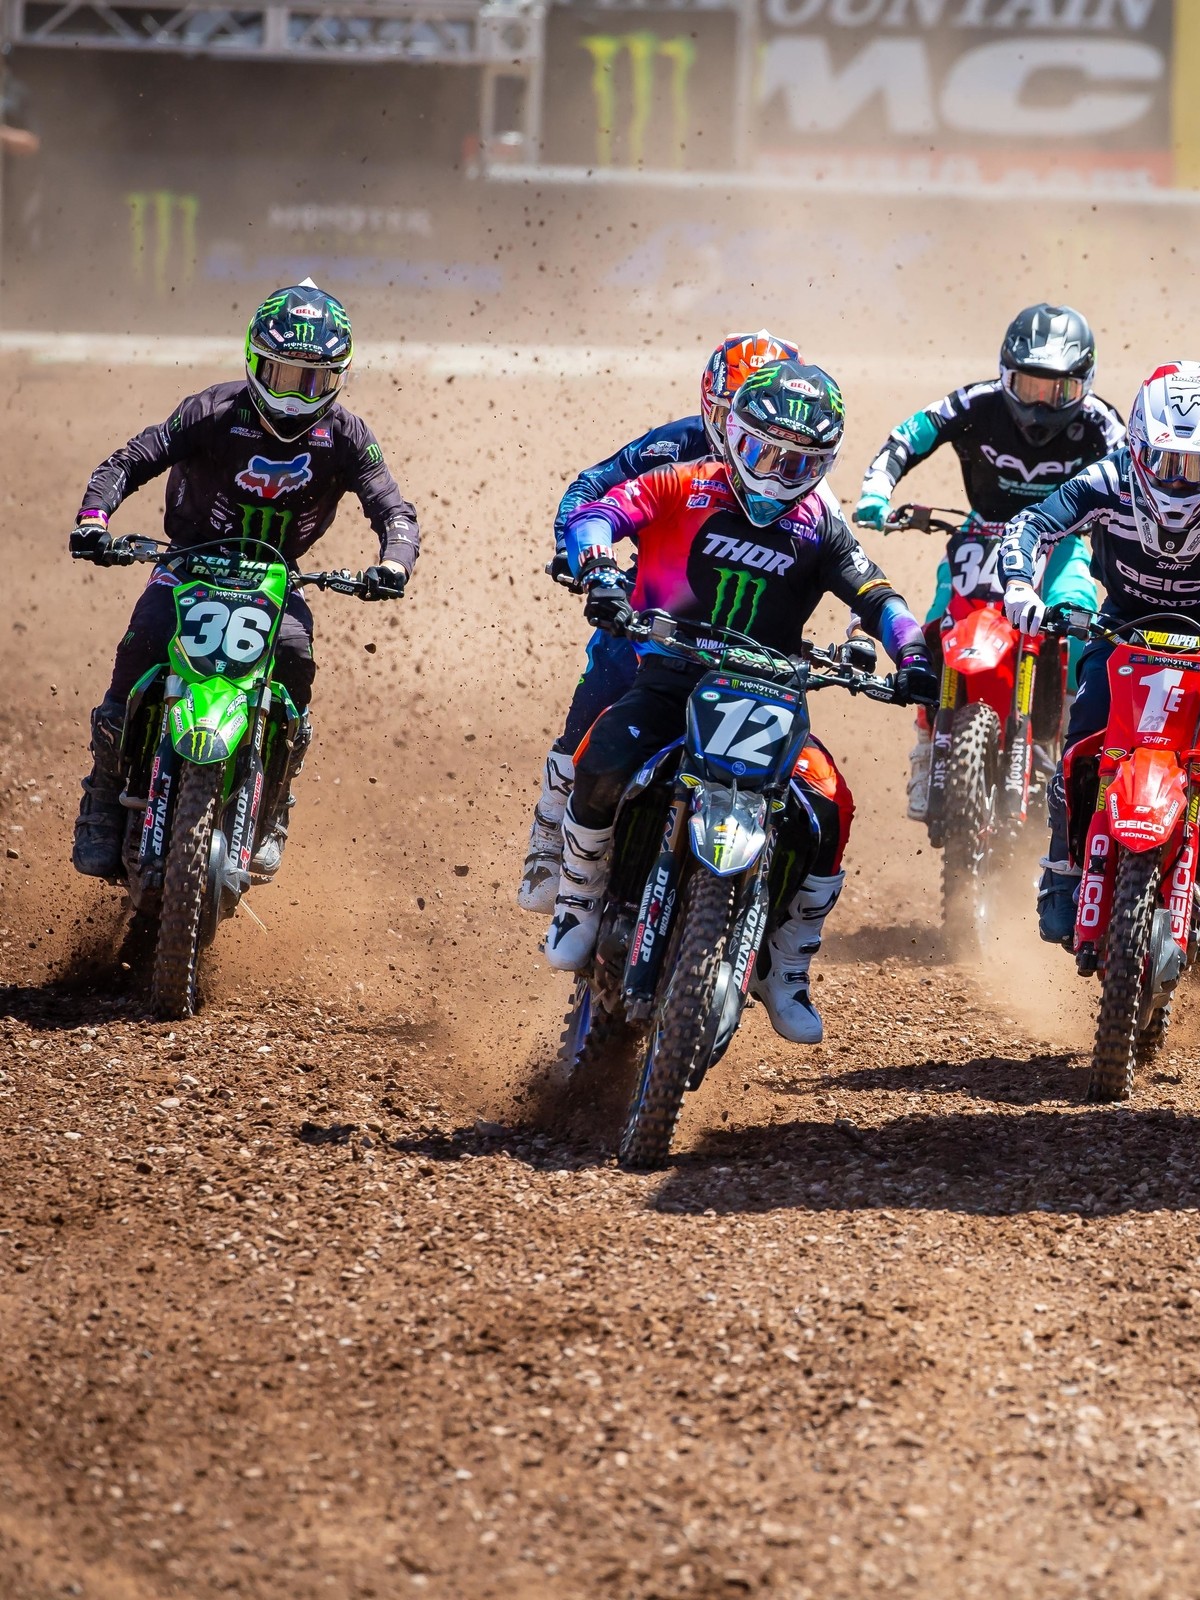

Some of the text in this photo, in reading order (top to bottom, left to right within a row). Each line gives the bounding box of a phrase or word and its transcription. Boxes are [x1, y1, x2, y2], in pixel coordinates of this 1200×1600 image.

[757, 36, 1166, 136] MC
[295, 308, 317, 317] BELL
[283, 342, 324, 353] MONSTER
[789, 380, 814, 394] BELL
[774, 415, 816, 436] MONSTER
[701, 533, 795, 577] THOR
[1156, 562, 1191, 571] SHIFT
[215, 590, 253, 602] MONSTER
[180, 601, 272, 663] 36
[1154, 656, 1193, 668] MONSTER
[739, 680, 780, 697] MONSTER
[1140, 715, 1165, 731] 23
[703, 698, 795, 767] 12
[1141, 735, 1172, 746] SHIFT
[228, 785, 249, 868] DUNLOP
[1114, 819, 1165, 835] GEICO
[1120, 831, 1157, 842] HONDA
[1081, 834, 1110, 928] GICO
[1170, 844, 1194, 940] GEICO
[630, 923, 645, 967] BRAKING
